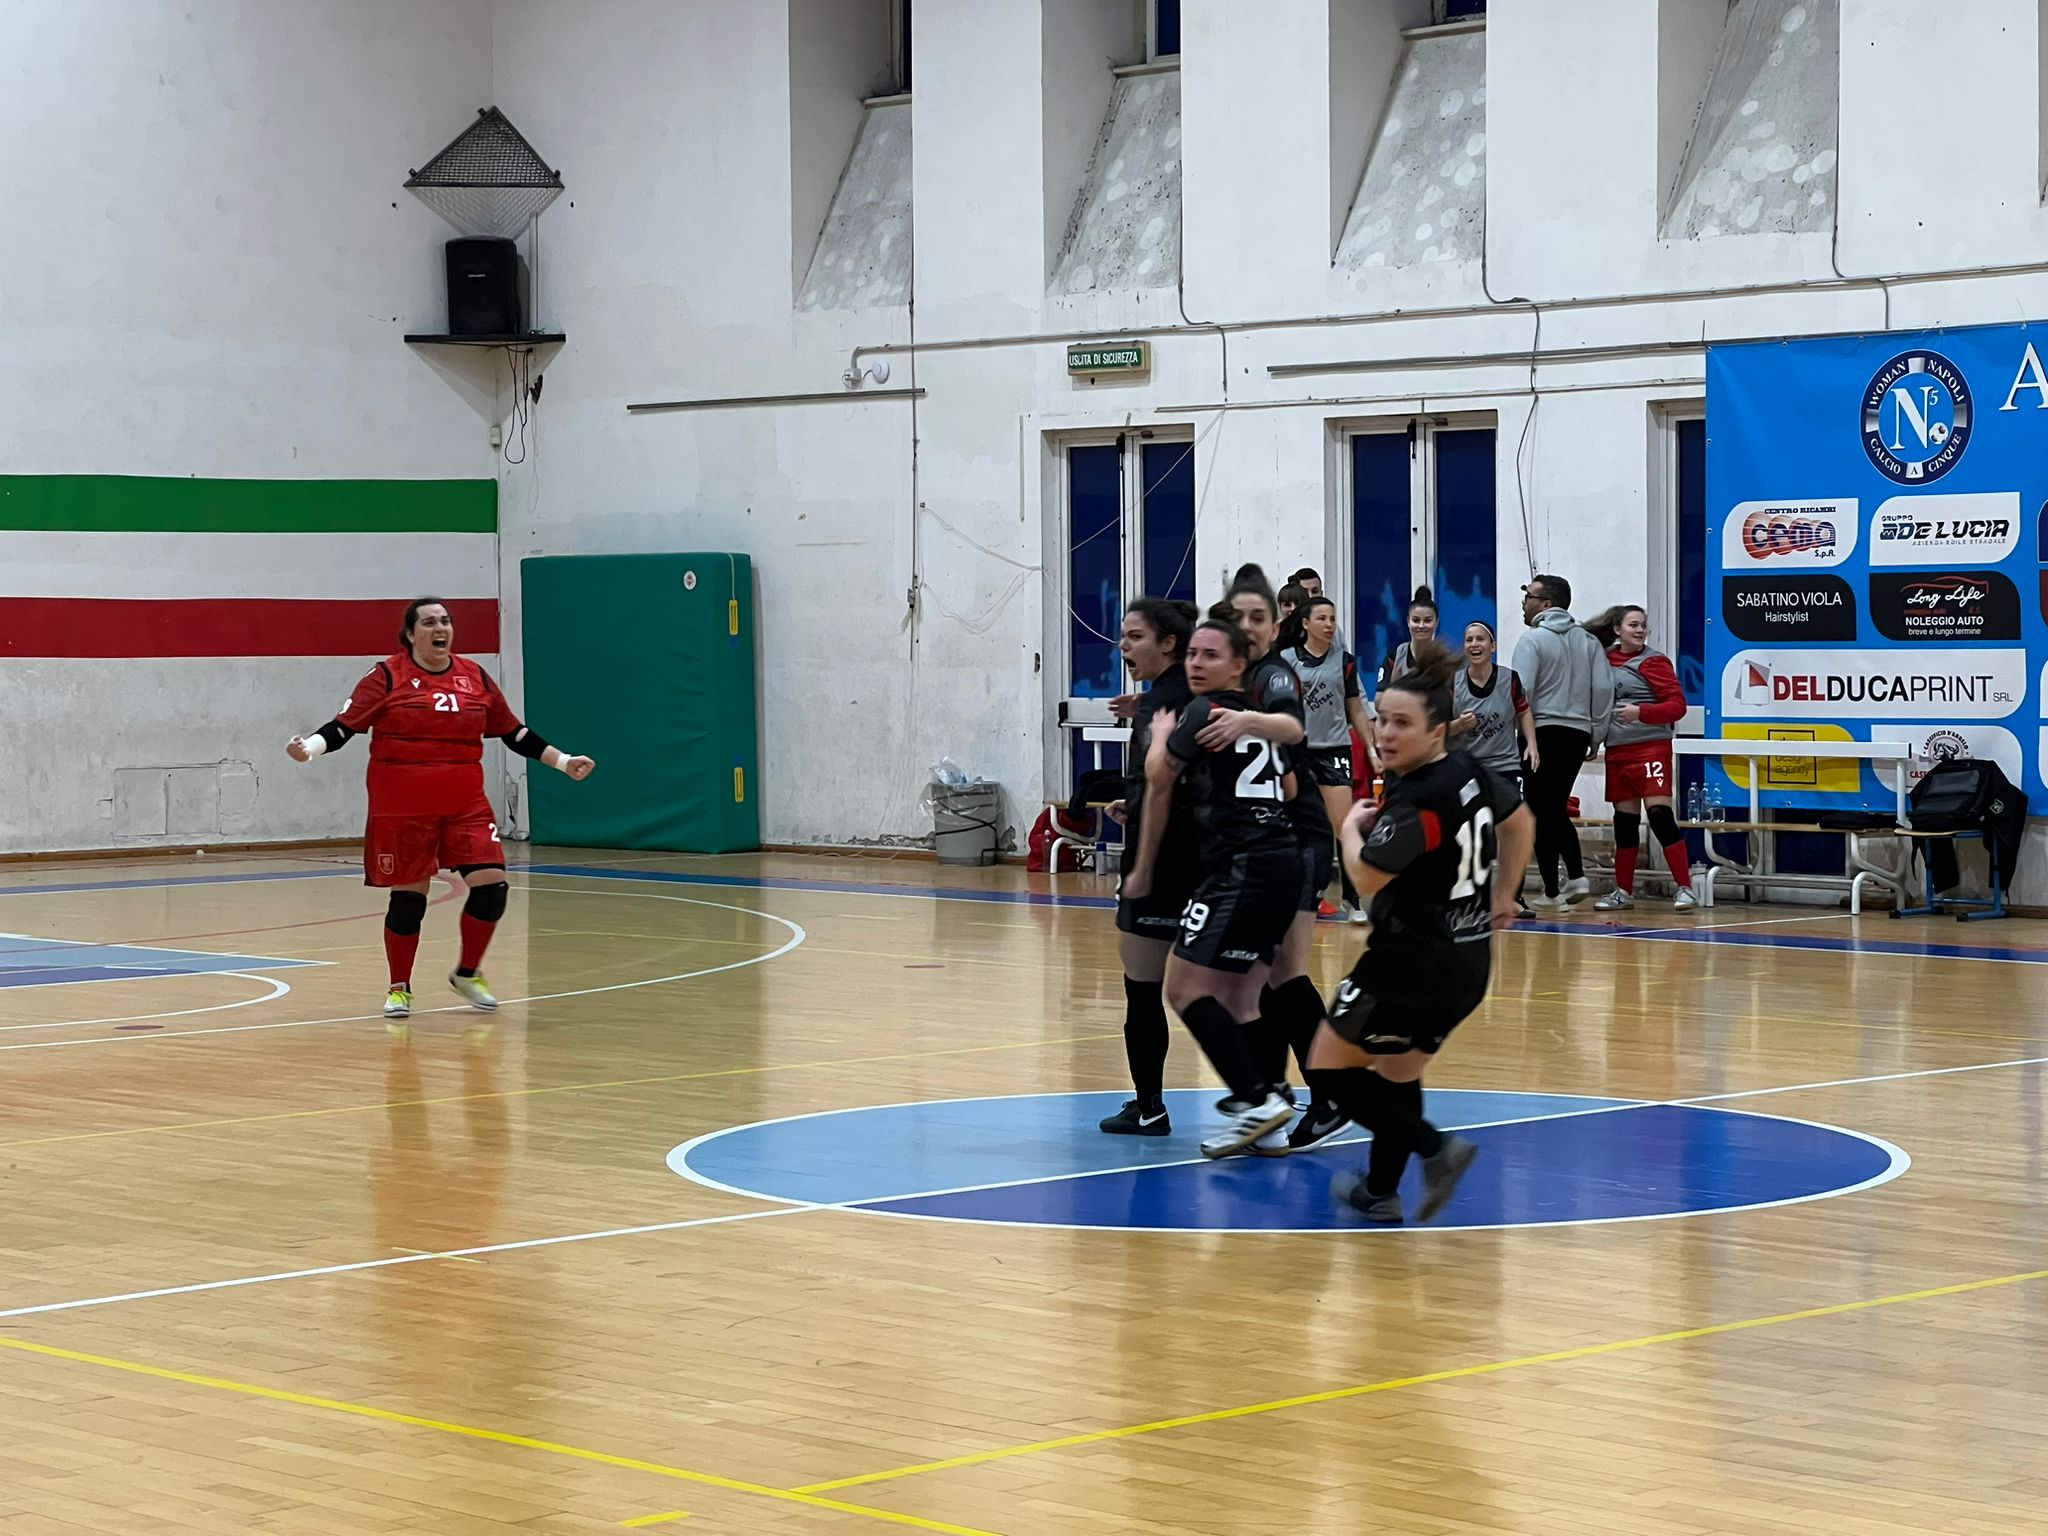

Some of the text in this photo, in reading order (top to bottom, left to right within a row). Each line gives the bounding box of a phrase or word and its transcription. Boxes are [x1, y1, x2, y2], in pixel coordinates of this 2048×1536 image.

[1093, 353, 1101, 365] DI
[1102, 351, 1138, 365] SICUREZZA
[1869, 359, 1965, 405] WOMAN NAPOLI
[1869, 437, 1901, 475] CALCIO
[1928, 433, 1962, 473] CINQUE
[1935, 519, 2010, 539] LUCIA
[1736, 591, 1843, 607] SABATINO VIOLA
[1906, 584, 1985, 609] Long Life
[1764, 611, 1809, 625] Hairstylist
[1905, 616, 1984, 626] NOLEGGIO AUTO
[1908, 628, 1928, 636] breve
[1934, 627, 1954, 637] lungo
[1955, 627, 1982, 636] termine
[432, 692, 460, 712] 21
[1992, 692, 2013, 703] SRL
[1644, 761, 1664, 778] 12
